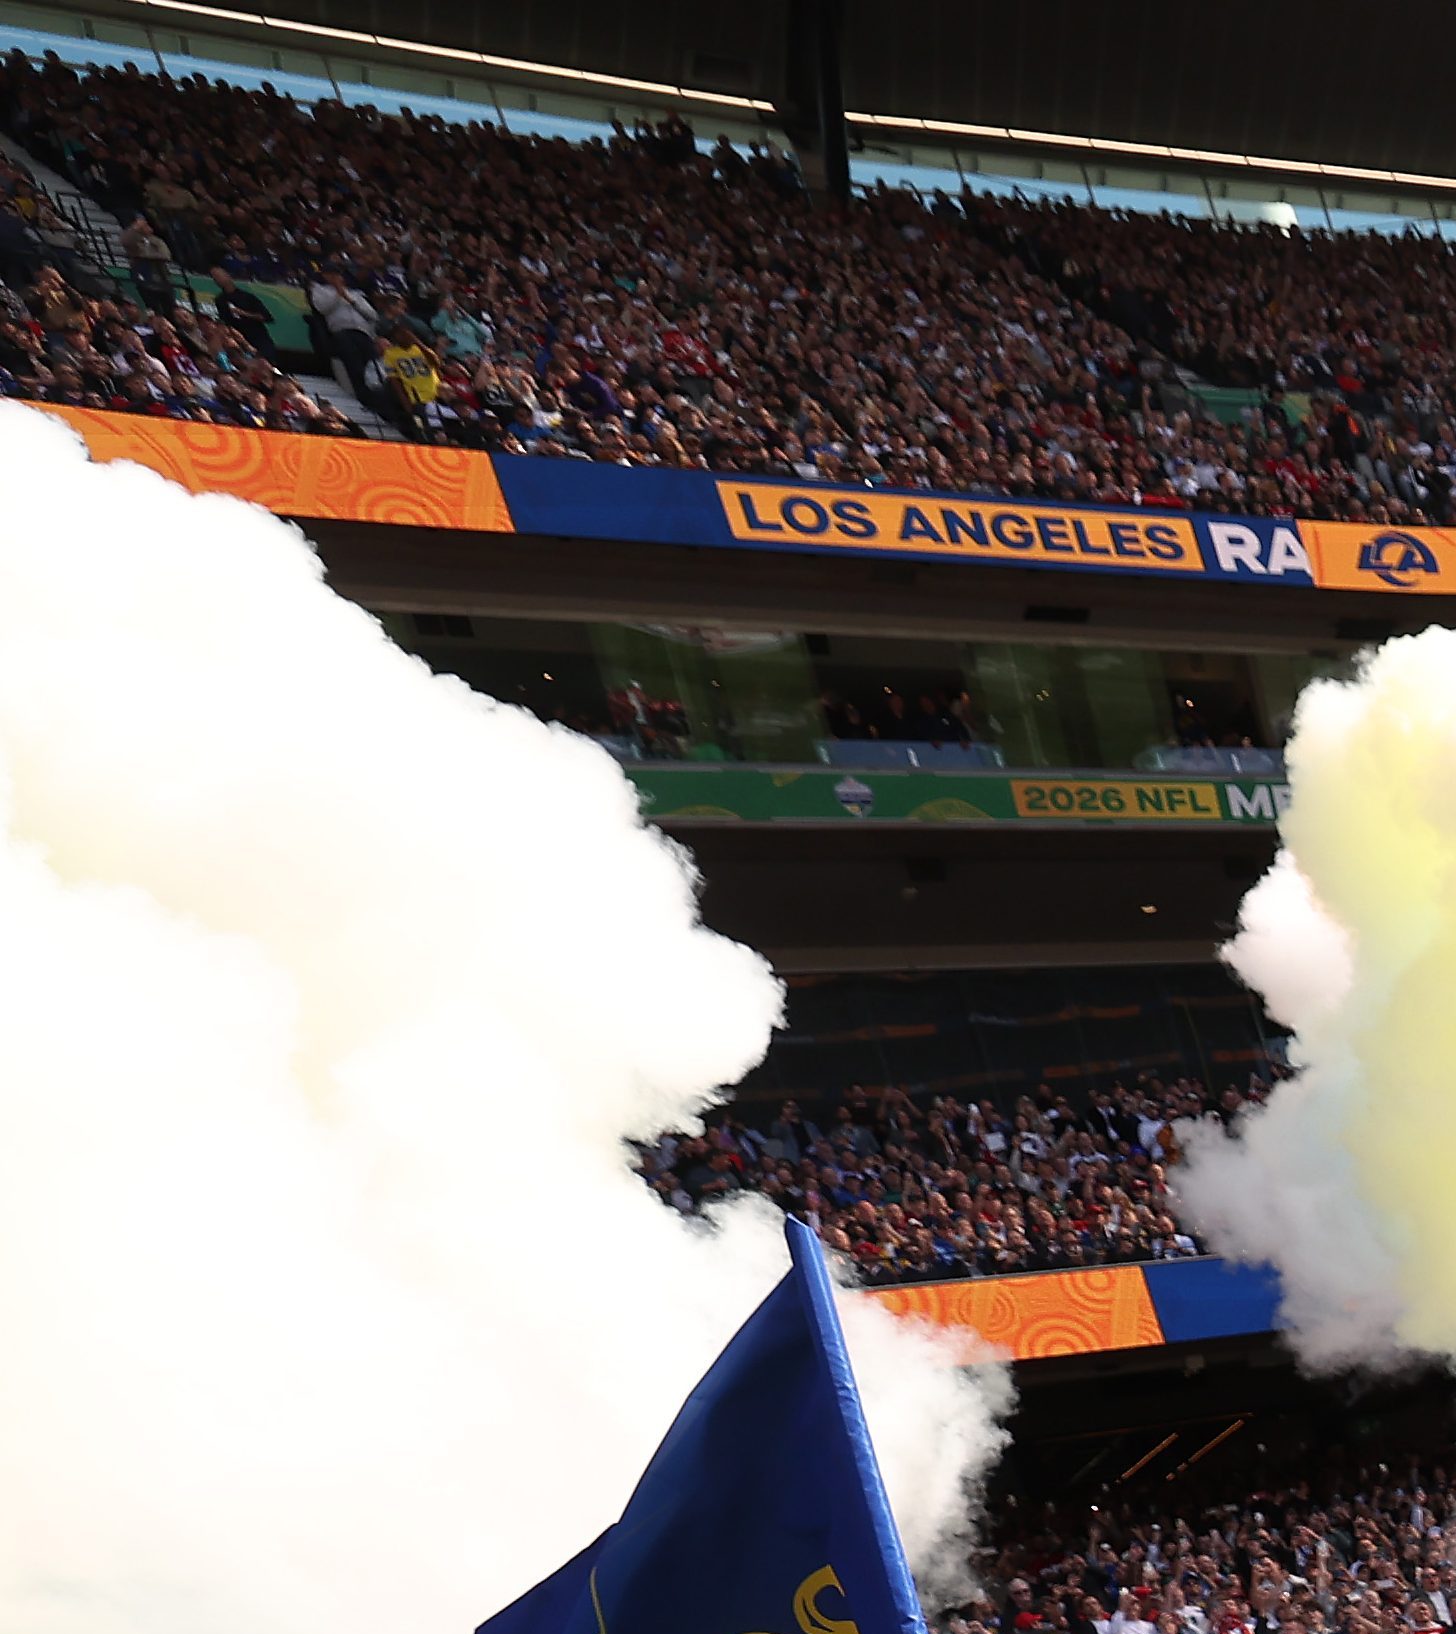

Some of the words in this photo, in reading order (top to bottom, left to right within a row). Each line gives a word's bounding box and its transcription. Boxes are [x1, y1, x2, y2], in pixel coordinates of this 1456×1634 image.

[738, 490, 878, 538] LOS
[899, 507, 1185, 561] ANGELES
[1207, 521, 1312, 576] RA
[1023, 786, 1125, 812] 2026
[1137, 788, 1211, 813] NFL
